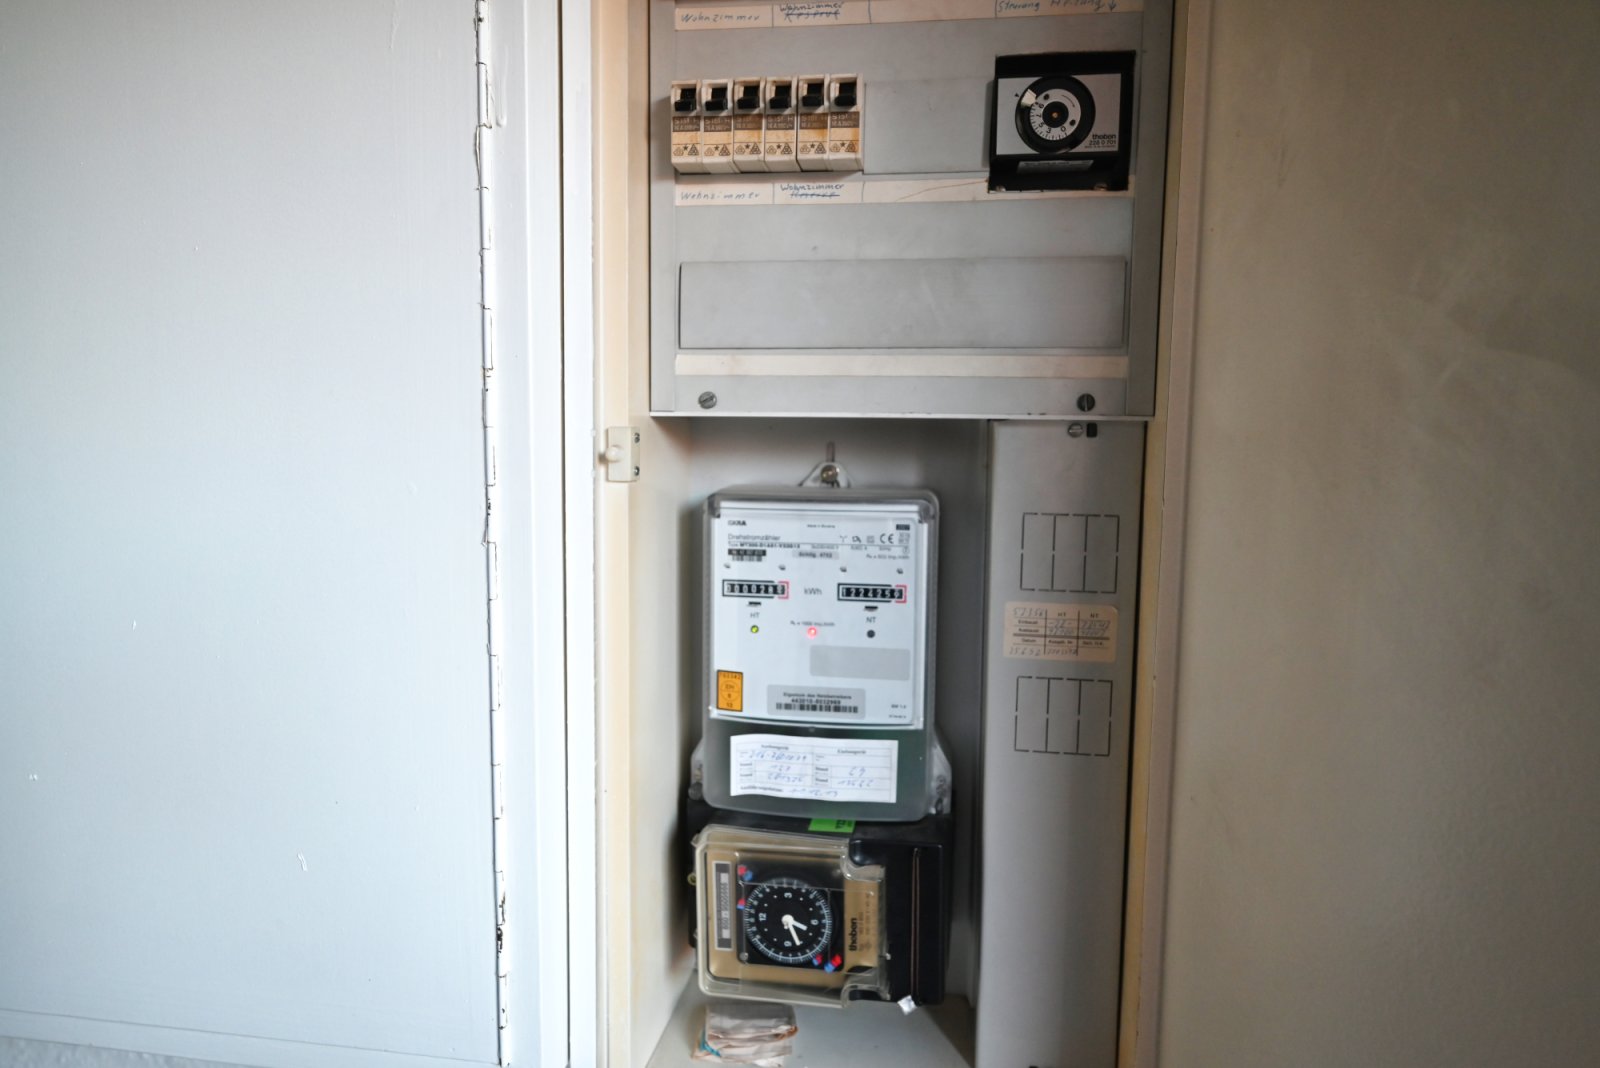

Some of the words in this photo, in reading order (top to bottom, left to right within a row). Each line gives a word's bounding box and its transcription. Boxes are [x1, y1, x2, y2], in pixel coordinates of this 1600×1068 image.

[681, 11, 760, 23] Wohnzimmer
[759, 913, 767, 921] 12
[848, 917, 858, 952] theben
